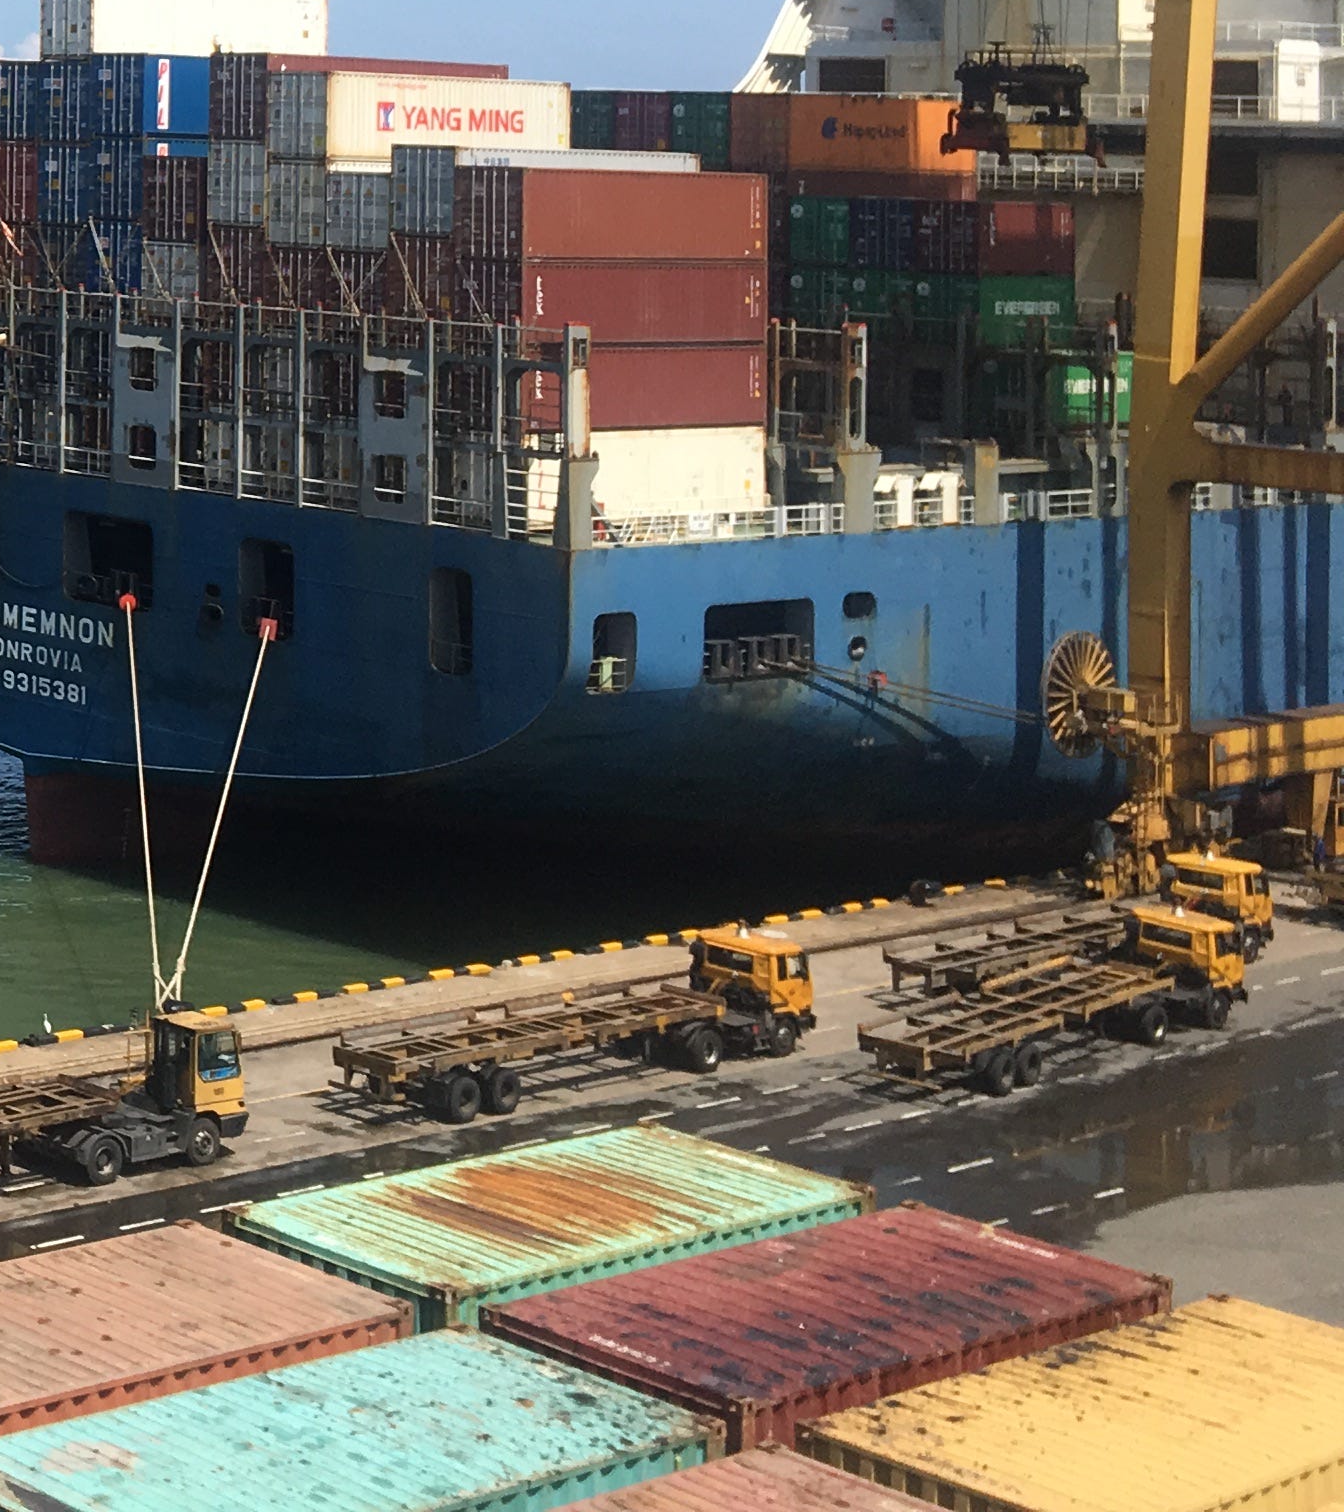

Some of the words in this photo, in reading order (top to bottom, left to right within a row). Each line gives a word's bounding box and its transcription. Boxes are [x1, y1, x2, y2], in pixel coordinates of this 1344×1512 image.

[402, 106, 462, 132] YANG
[468, 108, 525, 134] MING
[2, 670, 87, 706] 9315381
